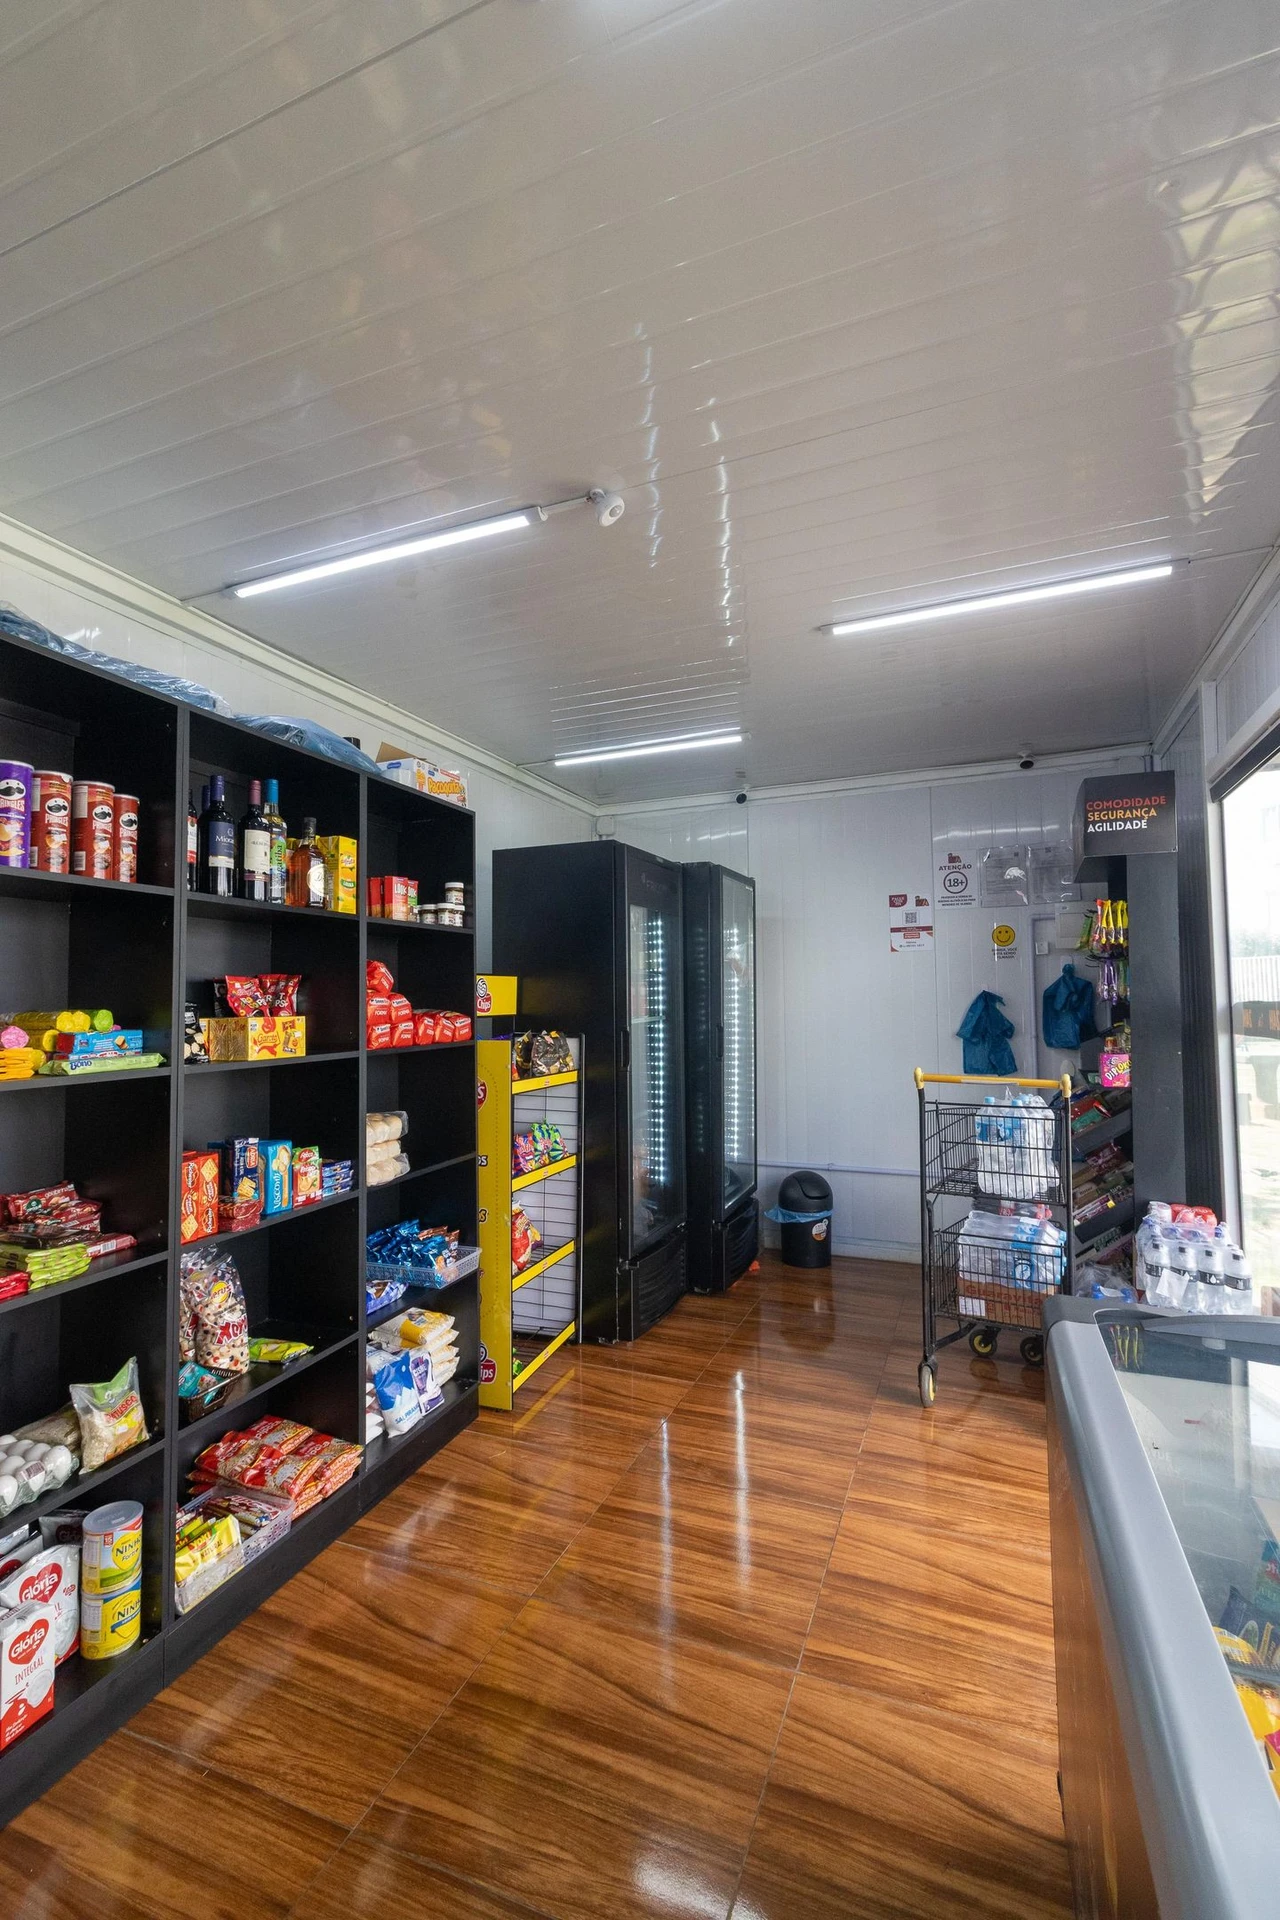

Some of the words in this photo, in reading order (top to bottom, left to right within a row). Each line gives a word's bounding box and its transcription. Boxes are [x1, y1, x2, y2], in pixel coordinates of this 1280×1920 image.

[1086, 796, 1166, 810] COMODIDADE
[1087, 808, 1157, 821] SEGURANÇA
[1087, 820, 1148, 832] AGILIDADE
[948, 878, 965, 888] 18+
[477, 998, 490, 1011] Chips
[70, 1060, 92, 1070] Bono
[480, 1367, 494, 1380] ips
[22, 1573, 58, 1602] Glória
[11, 1627, 46, 1658] Glória
[15, 1656, 44, 1685] INTEGRAL
